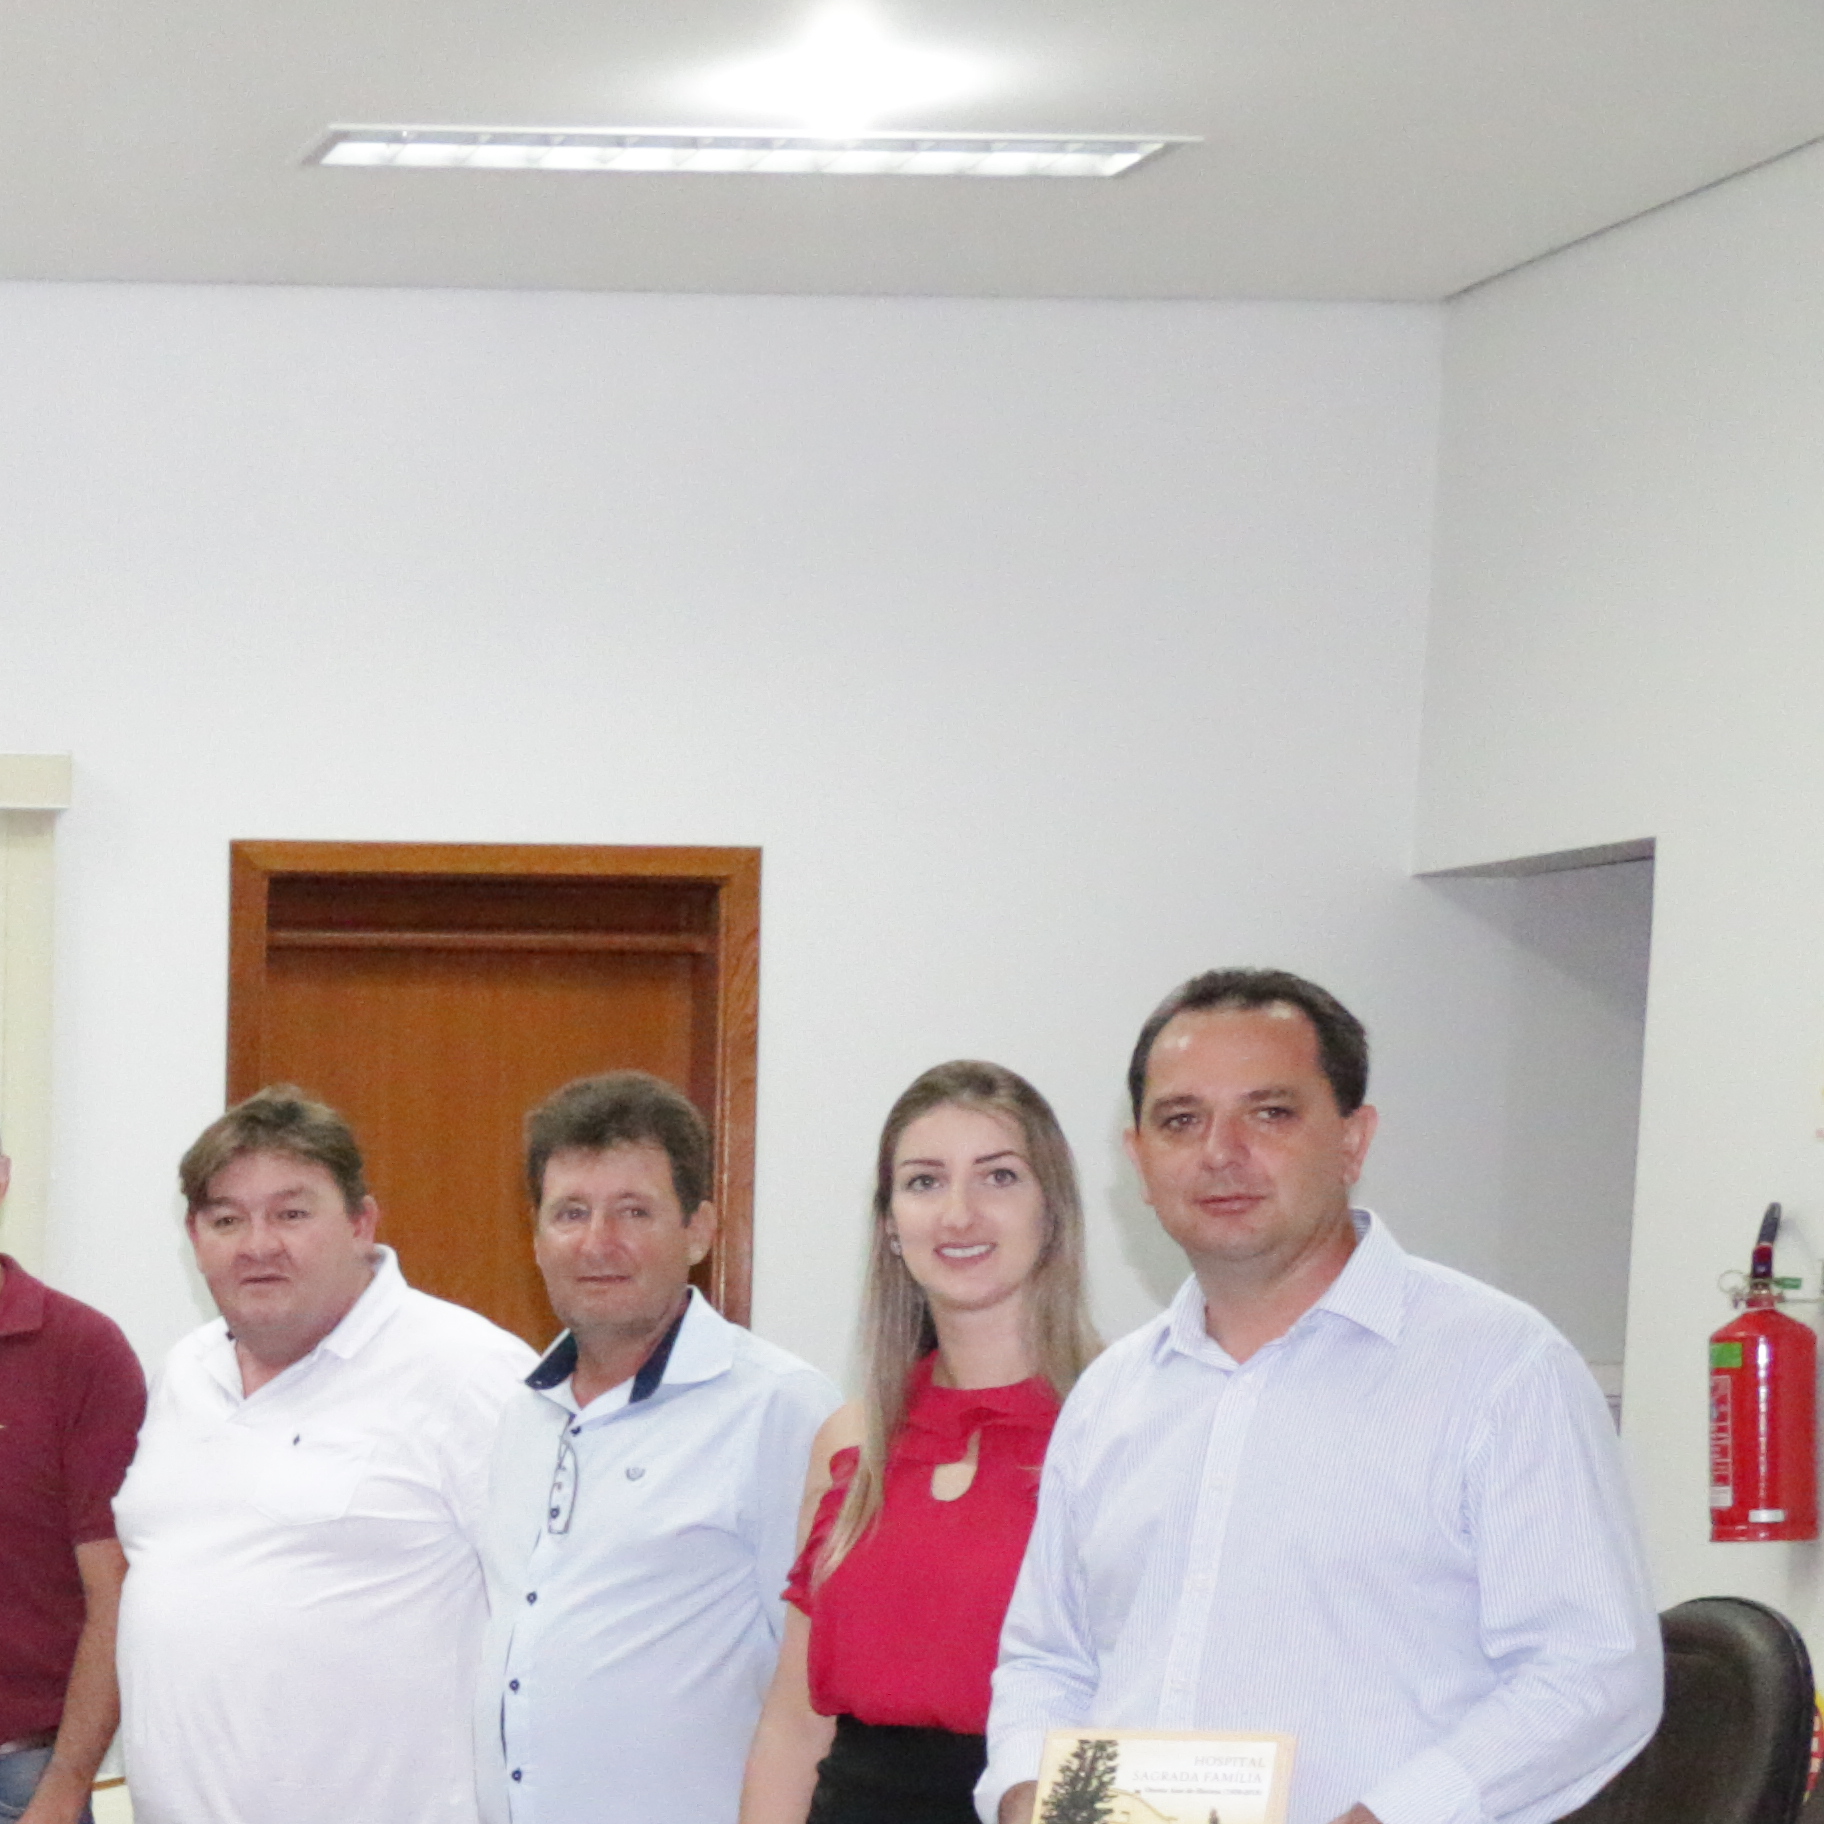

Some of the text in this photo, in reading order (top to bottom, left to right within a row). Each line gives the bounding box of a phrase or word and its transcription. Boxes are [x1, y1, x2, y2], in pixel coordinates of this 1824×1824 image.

[1194, 1755, 1266, 1768] HOSPITAL
[1132, 1769, 1262, 1783] SAGRADA FAMÍLIA
